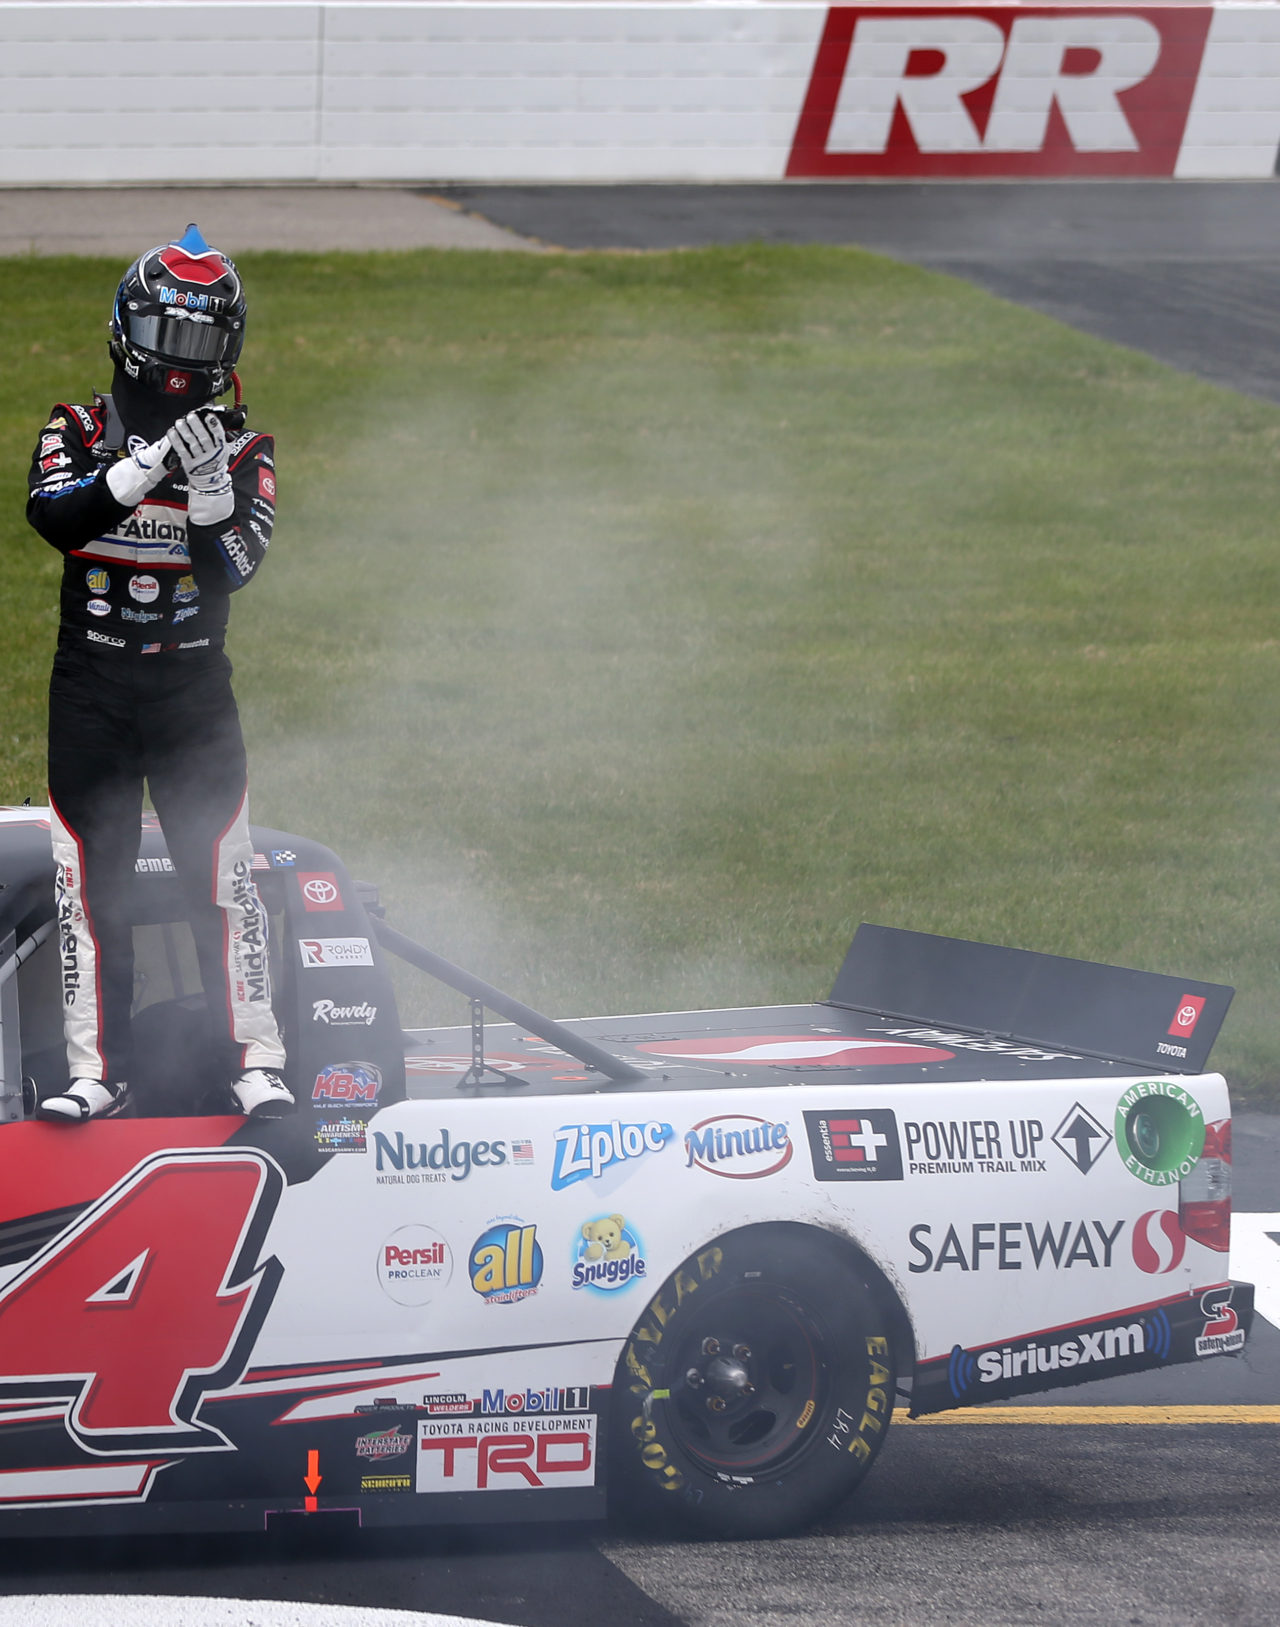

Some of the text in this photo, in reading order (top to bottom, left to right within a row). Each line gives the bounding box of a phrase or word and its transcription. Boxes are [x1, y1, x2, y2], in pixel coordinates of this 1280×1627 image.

[824, 15, 1161, 154] RR
[160, 285, 209, 312] Mobil
[88, 571, 108, 589] all
[87, 630, 126, 648] sparco
[324, 945, 368, 955] ROWDY
[313, 1000, 377, 1025] Rowdy
[1156, 1042, 1187, 1058] TOYOTA
[312, 1071, 378, 1101] KBM
[1118, 1082, 1200, 1118] AMERICAN
[320, 1124, 361, 1132] AUTISM
[819, 1119, 833, 1162] essentia
[904, 1119, 1043, 1161] POWER UP
[372, 1128, 506, 1181] Nudges
[555, 1120, 666, 1178] Ziploc
[685, 1120, 789, 1168] Minute
[376, 1173, 447, 1185] NATURAL DOG TREATS
[909, 1160, 1047, 1175] PREMIUM TRAIL MIX
[1124, 1155, 1199, 1184] ETHANOL
[385, 1242, 445, 1266] Persil
[472, 1224, 537, 1293] all
[908, 1220, 1125, 1273] SAFEWAY
[388, 1269, 441, 1279] PROCLEAN
[573, 1257, 646, 1287] Snuggle
[424, 1395, 465, 1404] LINCOLN
[432, 1403, 470, 1412] WELDERS
[481, 1387, 559, 1413] Mobil
[827, 1336, 890, 1464] EAGLE
[422, 1418, 593, 1435] TOYOTA RACING DEVELOPMENT
[421, 1432, 592, 1489] TRD
